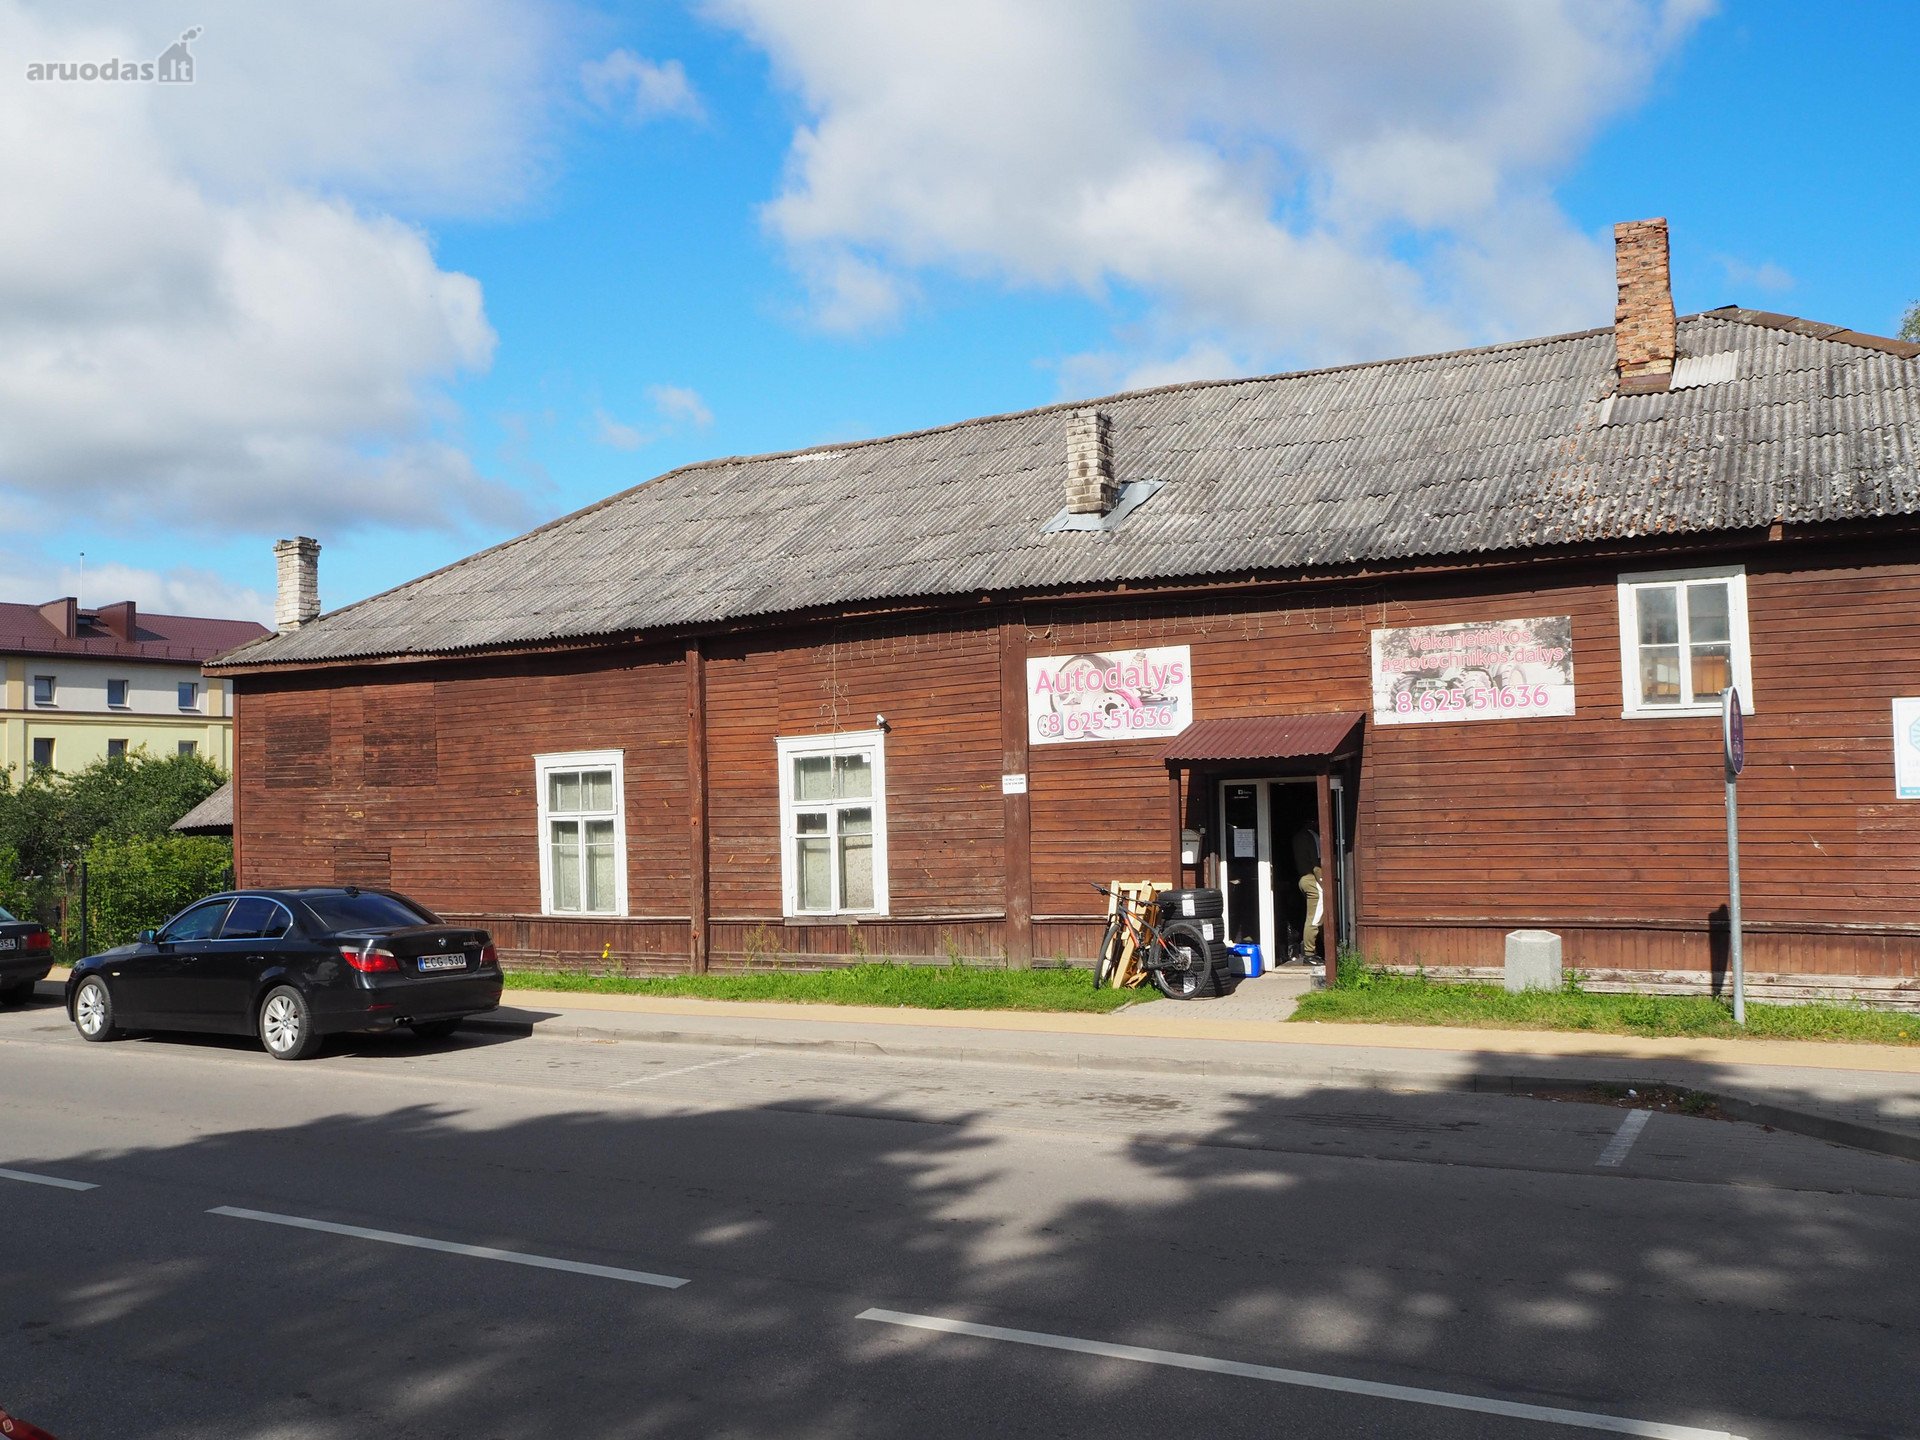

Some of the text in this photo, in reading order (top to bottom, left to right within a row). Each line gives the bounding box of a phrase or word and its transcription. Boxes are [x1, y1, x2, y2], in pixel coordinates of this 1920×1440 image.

[1382, 646, 1565, 673] agrotechnikos dalys
[1035, 659, 1185, 694] Autodalys
[1397, 684, 1549, 713] 8 625 51636
[1048, 706, 1172, 733] 8 625 51636
[424, 955, 464, 968] ECG 530
